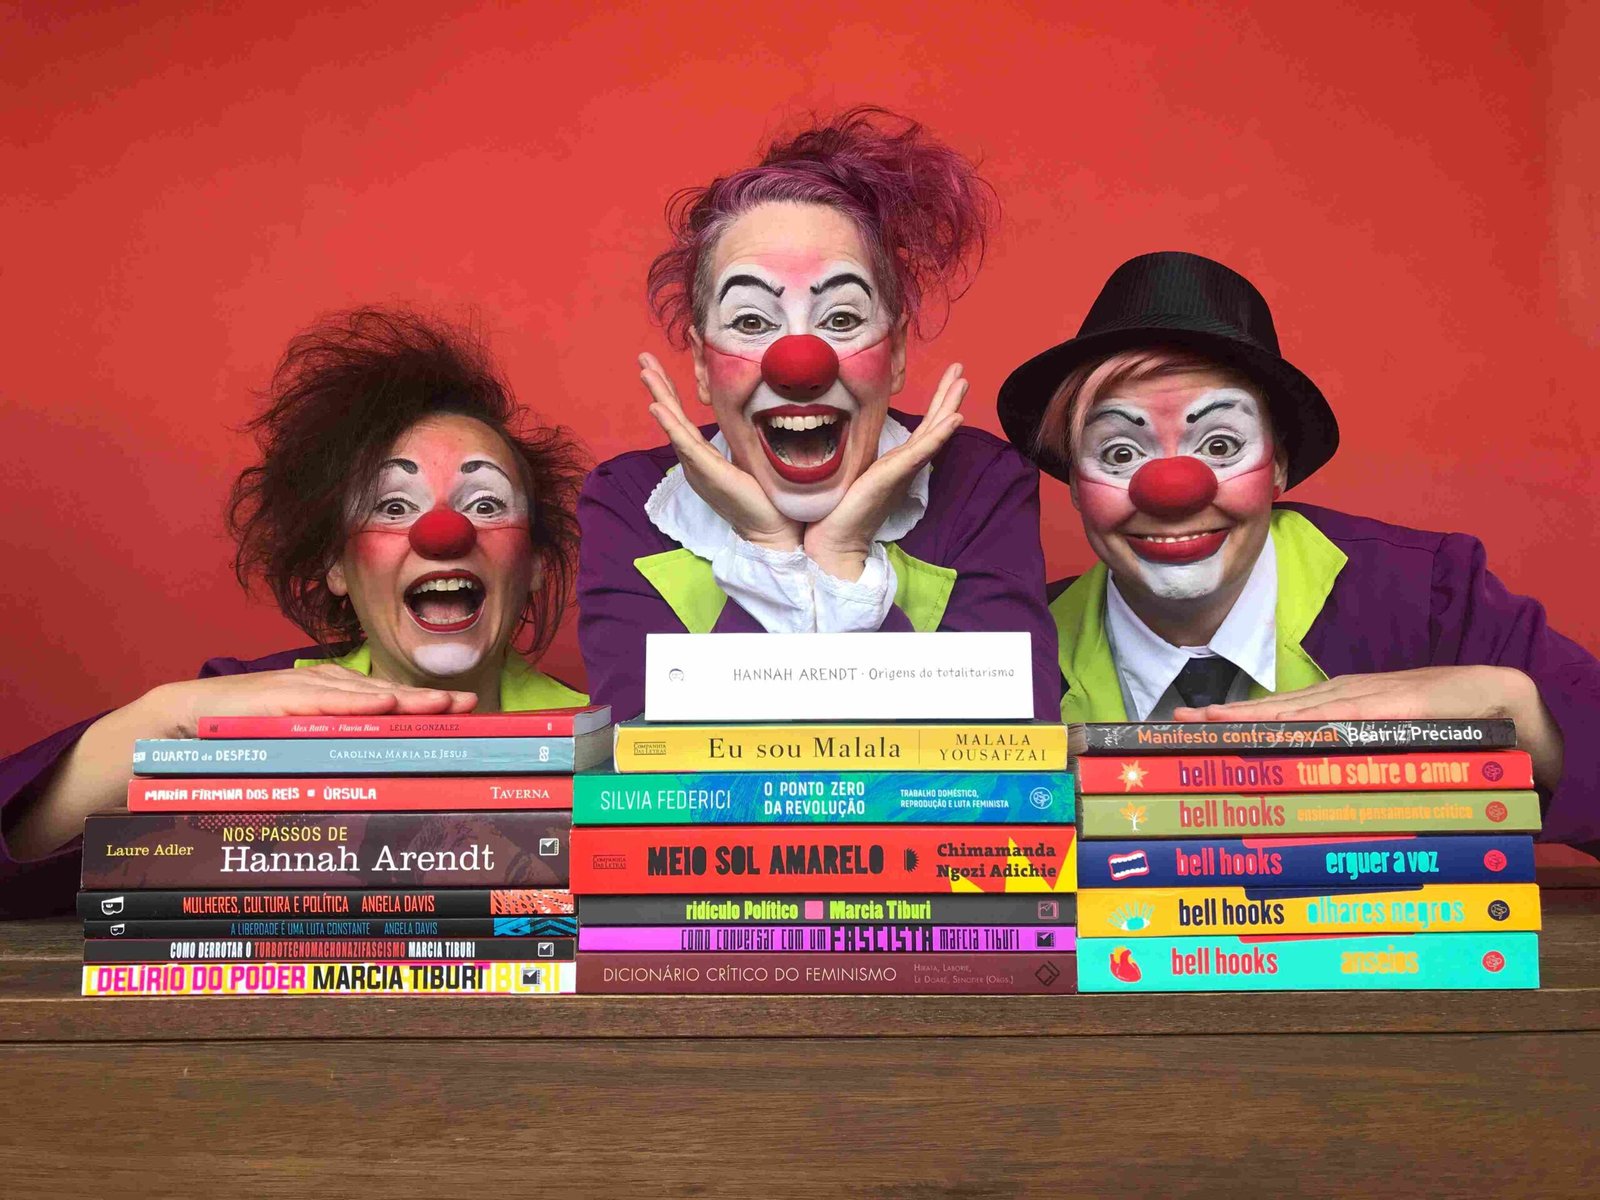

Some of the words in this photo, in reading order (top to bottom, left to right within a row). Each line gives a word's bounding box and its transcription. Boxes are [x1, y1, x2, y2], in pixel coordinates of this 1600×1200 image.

[733, 668, 793, 681] HANNAH
[799, 667, 857, 681] ARENDT
[869, 667, 916, 680] Origens
[937, 667, 1015, 678] totalitarismo
[956, 734, 1031, 746] MALALA
[1138, 728, 1218, 744] Manifesto
[1223, 727, 1340, 743] contrassexual
[1348, 726, 1407, 741] Beatriz
[1411, 726, 1483, 741] Preciado
[152, 750, 199, 762] QUARTO
[201, 752, 213, 761] de
[215, 750, 268, 762] DESPEJO
[329, 749, 383, 759] CAROLINA
[385, 750, 421, 759] MARIA
[439, 749, 468, 759] JESUS
[708, 737, 742, 759] Eu
[756, 743, 801, 759] sou
[813, 736, 901, 759] Malala
[939, 749, 1046, 761] YOUSAFZAI
[1179, 760, 1216, 787] bell
[1222, 760, 1284, 787] hooks
[1297, 758, 1342, 785] tudo
[1346, 757, 1400, 785] sobre
[1405, 762, 1416, 783] o
[1421, 761, 1471, 784] amor
[246, 789, 269, 800] DOS
[272, 787, 300, 800] REIS
[490, 786, 550, 800] TAVERNA
[764, 781, 773, 797] O
[780, 781, 824, 796] PONTO
[831, 781, 865, 796] ZERO
[900, 789, 937, 798] TRABALHO
[937, 787, 979, 799] DOMÉSTICO,
[600, 790, 652, 810] SILVIA
[658, 789, 731, 810] FEDERICI
[764, 800, 782, 815] DA
[786, 797, 865, 817] REVOLUÇÃO
[900, 798, 947, 810] REPRODUÇÃO
[953, 800, 971, 808] LUTA
[972, 799, 1009, 808] FEMINISTA
[1179, 800, 1218, 828] bell
[1223, 798, 1286, 828] hooks
[1297, 804, 1357, 821] ensinando
[1359, 806, 1431, 824] pensamento
[223, 827, 255, 842] NOS
[261, 827, 321, 842] PASSOS
[328, 827, 348, 842] DE
[106, 844, 149, 857] Laure
[154, 844, 194, 856] Adler
[220, 846, 360, 872] Hannah
[372, 844, 495, 872] Arendt
[937, 843, 1056, 857] Chimamanda
[648, 846, 706, 876] MEIO
[715, 845, 760, 875] SOL
[769, 845, 884, 875] AMARELO
[1176, 847, 1215, 877] bell
[1219, 847, 1283, 876] hooks
[1326, 851, 1389, 880] erguer
[1393, 851, 1405, 873] a
[1406, 850, 1440, 873] voz
[936, 864, 985, 882] Ngozi
[989, 863, 1056, 878] Adichie
[183, 895, 241, 915] MULHERES,
[244, 895, 290, 914] CULTURA
[303, 892, 349, 913] POLÍTICA
[362, 895, 401, 913] ANGELA
[404, 895, 435, 912] DAVIS
[685, 900, 740, 920] ridículo
[744, 900, 798, 920] Político
[829, 900, 884, 920] Marcia
[886, 900, 931, 920] Tiburi
[1179, 898, 1217, 926] bell
[1222, 898, 1285, 926] hooks
[1306, 896, 1385, 924] olhares
[1391, 900, 1465, 929] negros
[238, 923, 278, 935] LIBERDADE
[288, 923, 304, 935] UMA
[306, 923, 325, 935] LUTA
[327, 922, 371, 935] CONSTANTE
[384, 922, 413, 935] ANGELA
[415, 922, 438, 935] DAVIS
[831, 926, 934, 951] FASCISTA
[170, 941, 196, 958] COMO
[198, 941, 243, 958] DERROTAR
[254, 941, 406, 958] TURBOTECNOMACHONAZIFASCISMO
[408, 941, 442, 958] MARCIA
[445, 941, 475, 958] TIBURI
[1171, 947, 1210, 975] bell
[1215, 947, 1278, 975] hooks
[1340, 944, 1419, 974] anseios
[97, 965, 185, 992] DELÍRIO
[192, 965, 222, 991] DO
[230, 964, 306, 991] PODER
[313, 965, 403, 990] MARCIA
[409, 965, 484, 990] TIBURI
[603, 965, 700, 982] DICIONÁRIO
[706, 965, 768, 982] CRÍTICO
[775, 967, 800, 982] DO
[806, 967, 897, 982] FEMINISMO
